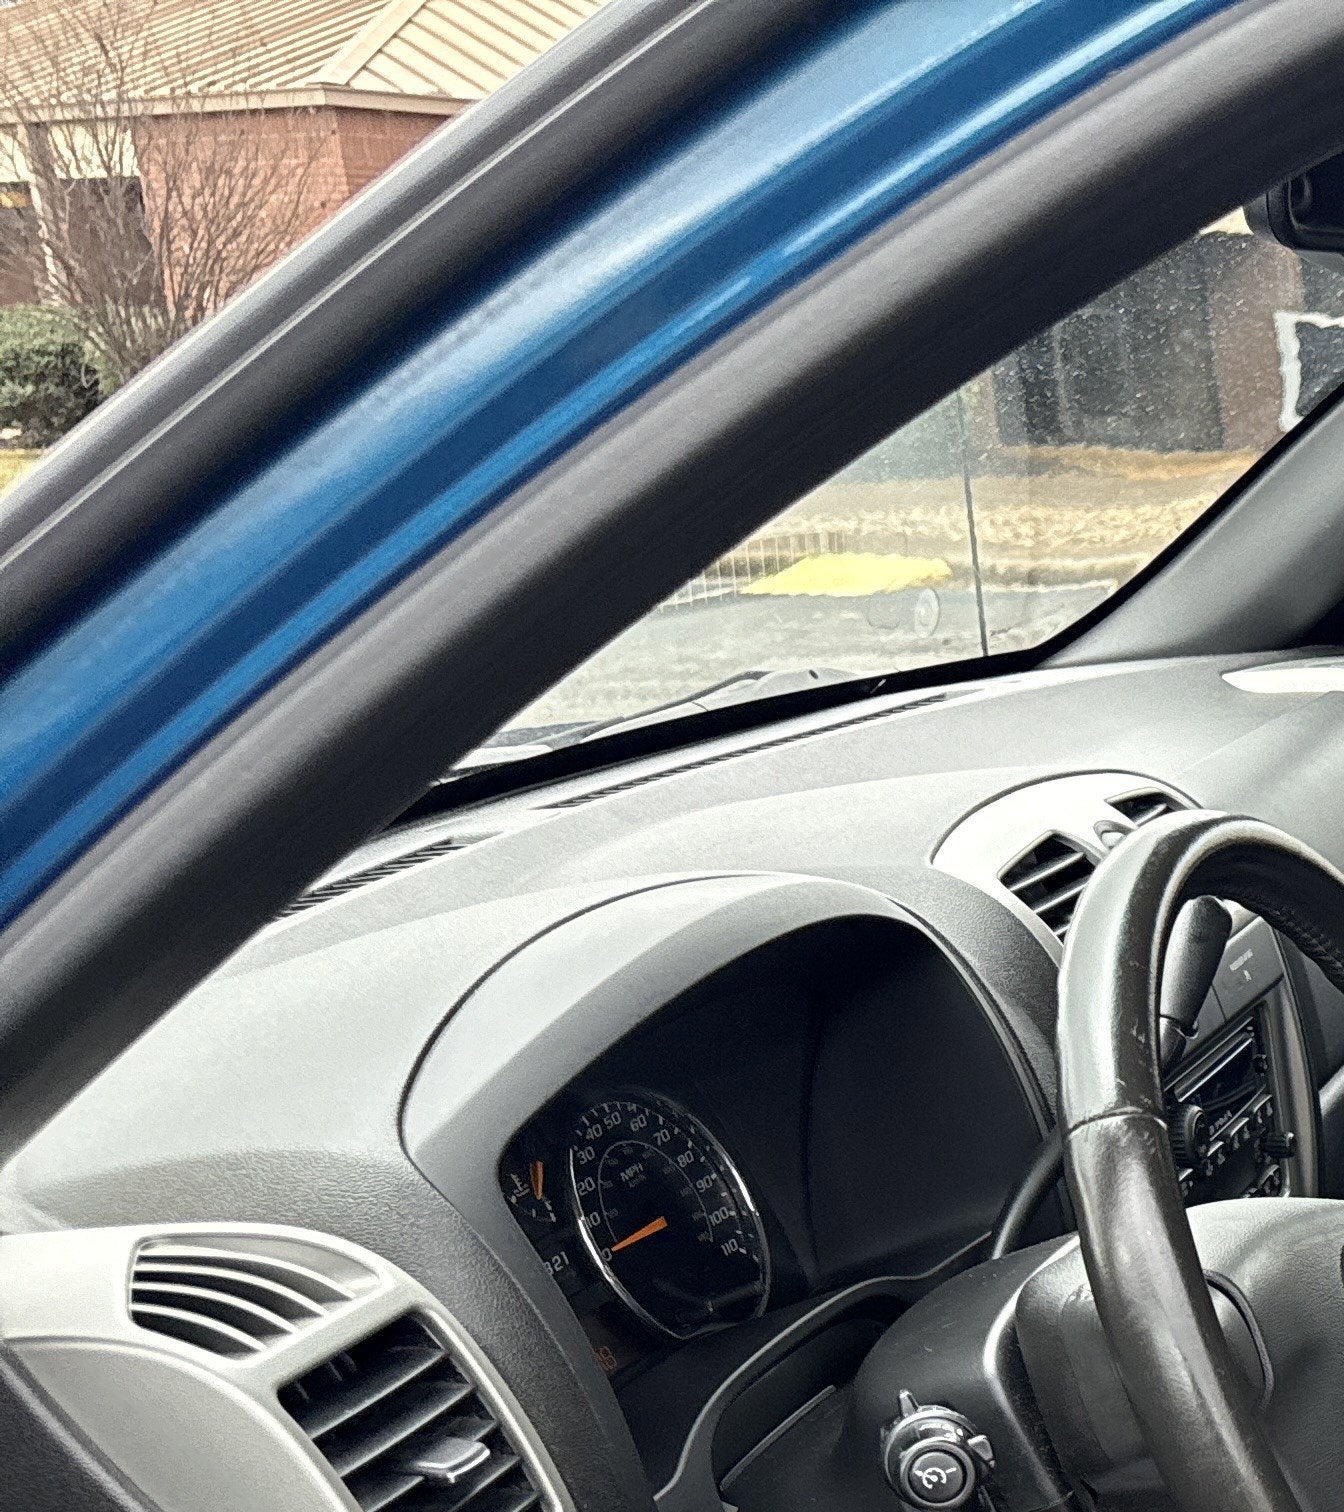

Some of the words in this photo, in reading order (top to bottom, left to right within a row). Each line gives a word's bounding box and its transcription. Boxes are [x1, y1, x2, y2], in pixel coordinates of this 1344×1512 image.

[604, 1111, 621, 1130] 50
[629, 1113, 647, 1132] 60
[585, 1123, 603, 1140] 40
[653, 1128, 671, 1146] 70
[576, 1146, 595, 1165] 30
[677, 1150, 694, 1168] 80
[576, 1176, 596, 1196] 20
[695, 1175, 713, 1193] 90
[708, 1206, 729, 1226] 100
[721, 1238, 740, 1257] 110
